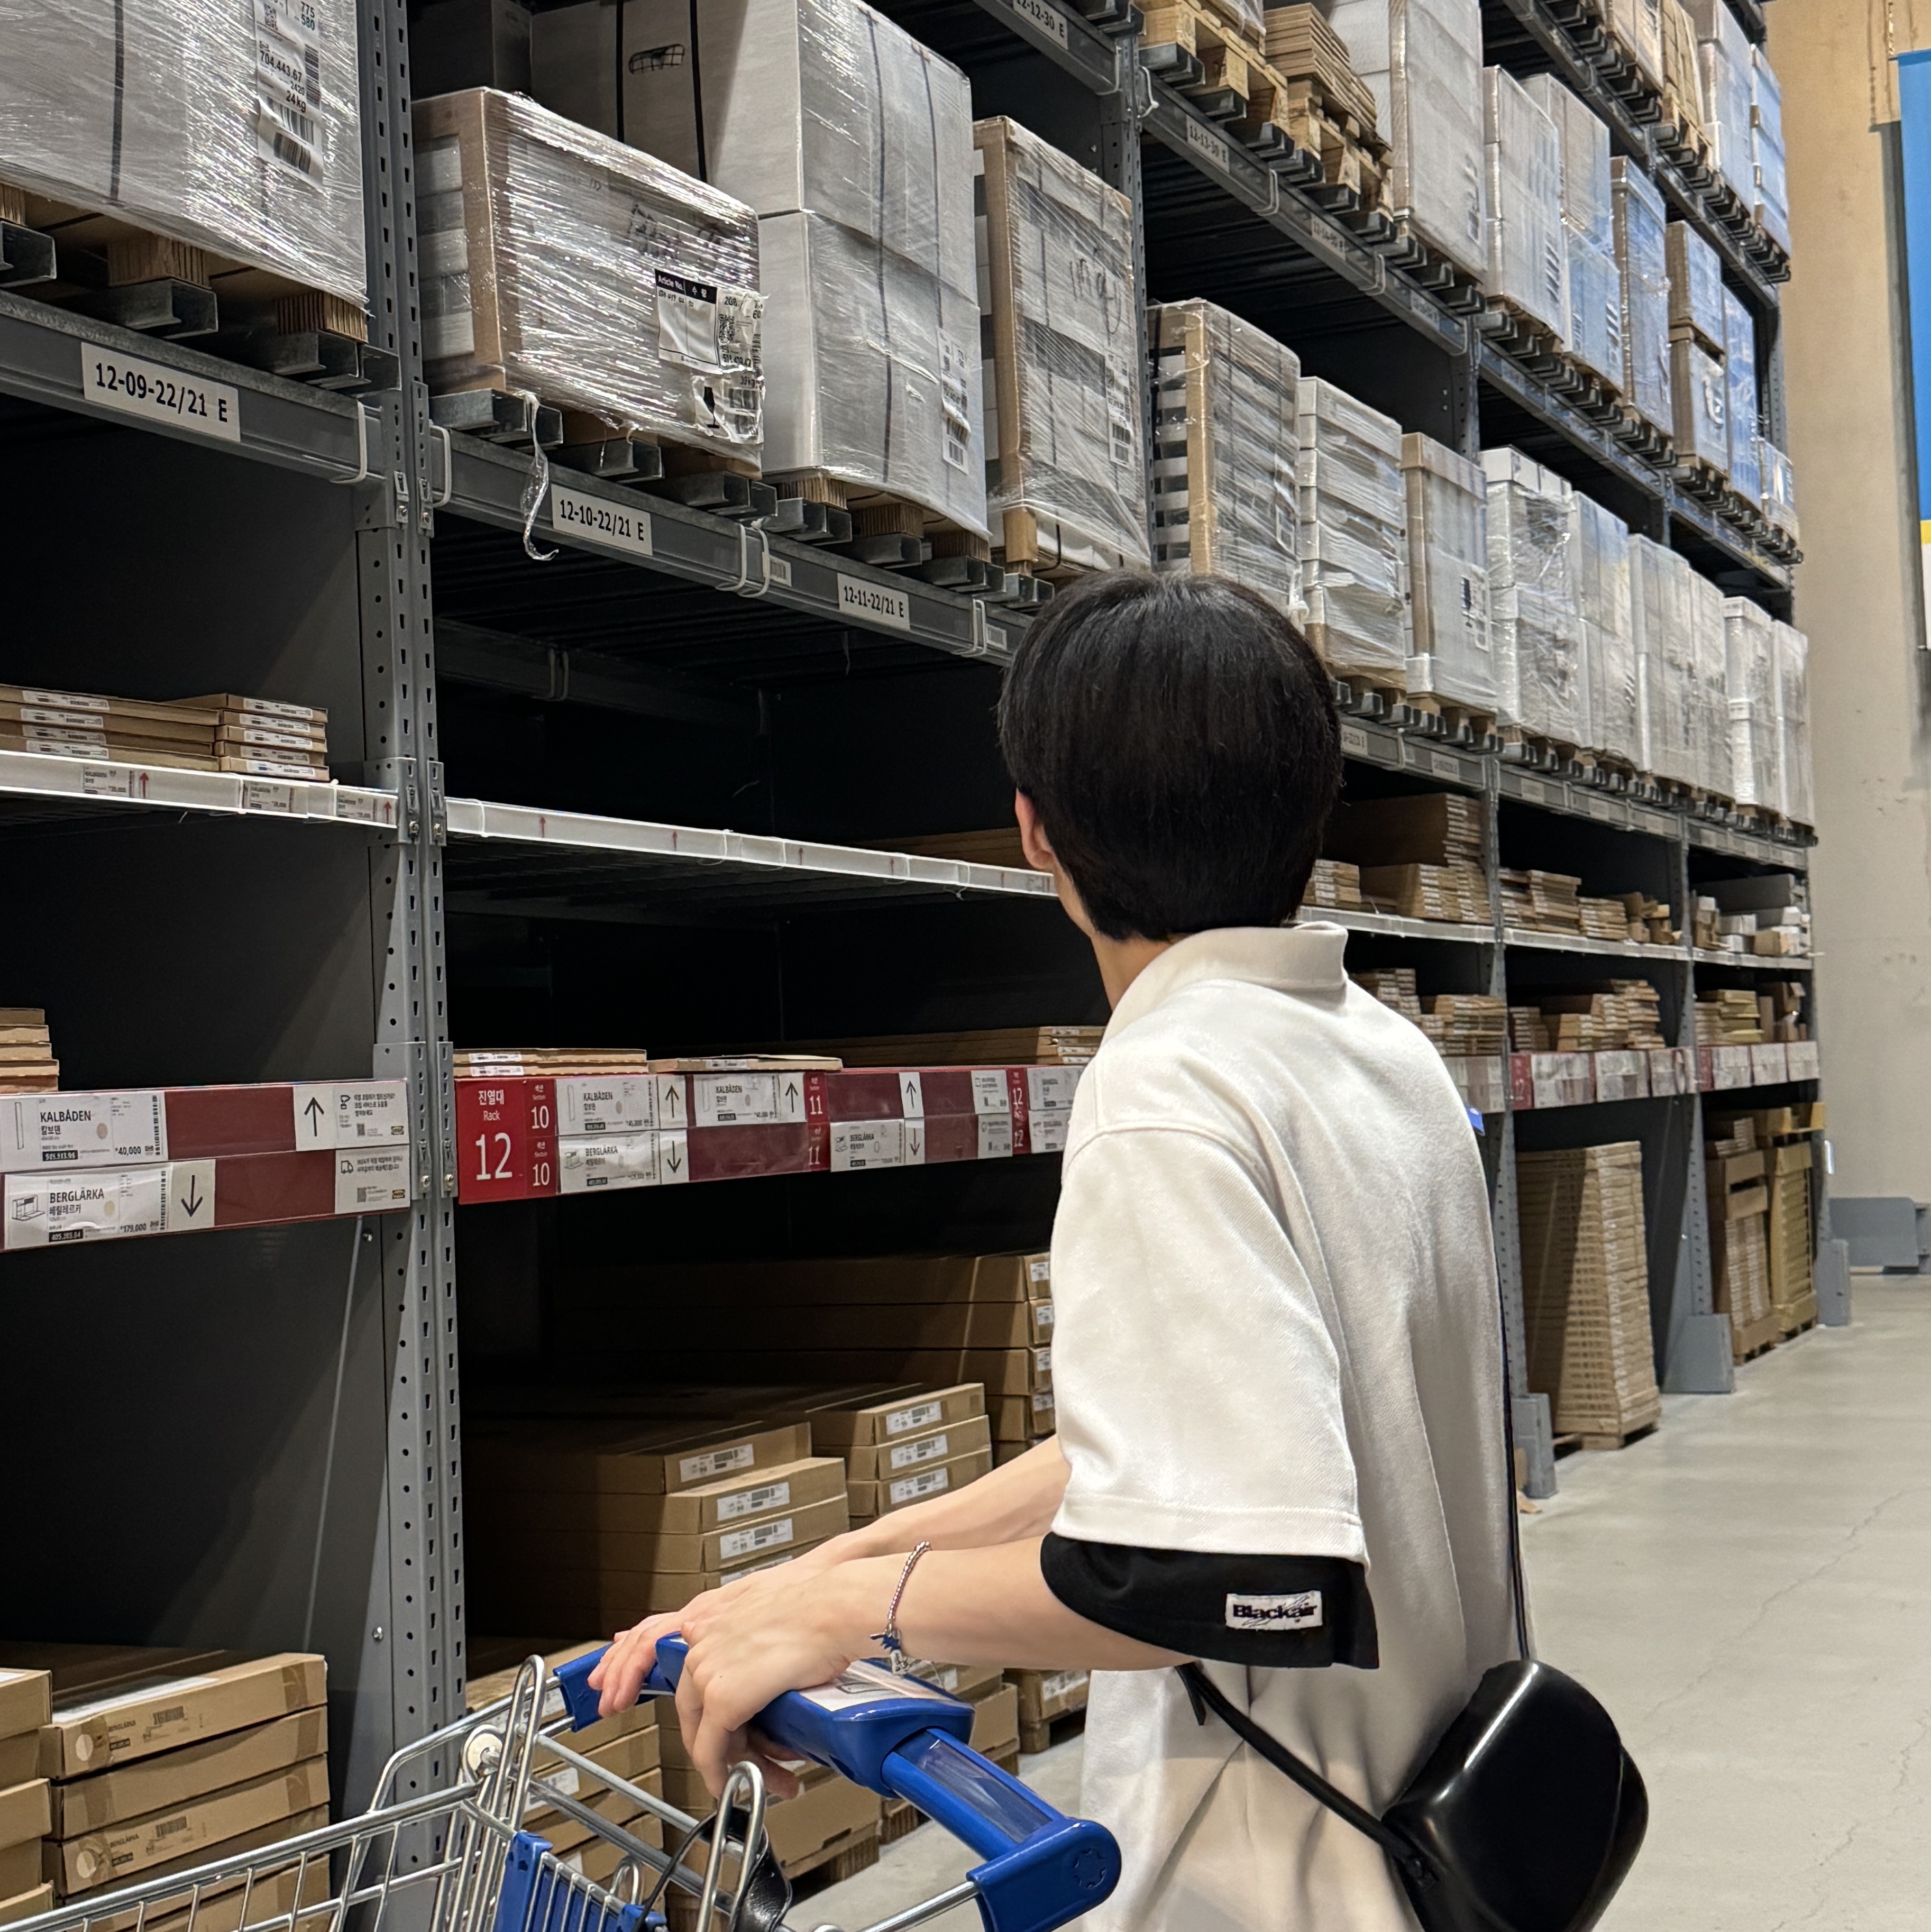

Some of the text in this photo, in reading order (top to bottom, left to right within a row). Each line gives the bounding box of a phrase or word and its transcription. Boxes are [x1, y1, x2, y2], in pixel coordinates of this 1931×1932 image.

[300, 1, 315, 18] 775
[300, 14, 315, 31] 580
[1059, 23, 1065, 39] E
[259, 50, 303, 83] 704.443.67
[96, 362, 228, 423] 12-09-22/21 E
[560, 499, 645, 542] 12-10-22/21 E
[844, 585, 904, 618] 12-11-22/21 E
[478, 1089, 505, 1106] 진열대
[809, 1095, 823, 1115] 11
[40, 1109, 91, 1122] KALBÅDEN
[483, 1110, 501, 1121] Rack
[531, 1105, 550, 1129] 10
[475, 1132, 513, 1180] 12
[808, 1146, 820, 1165] 11
[533, 1162, 550, 1186] 10
[50, 1187, 105, 1204] BERGLÄRKA
